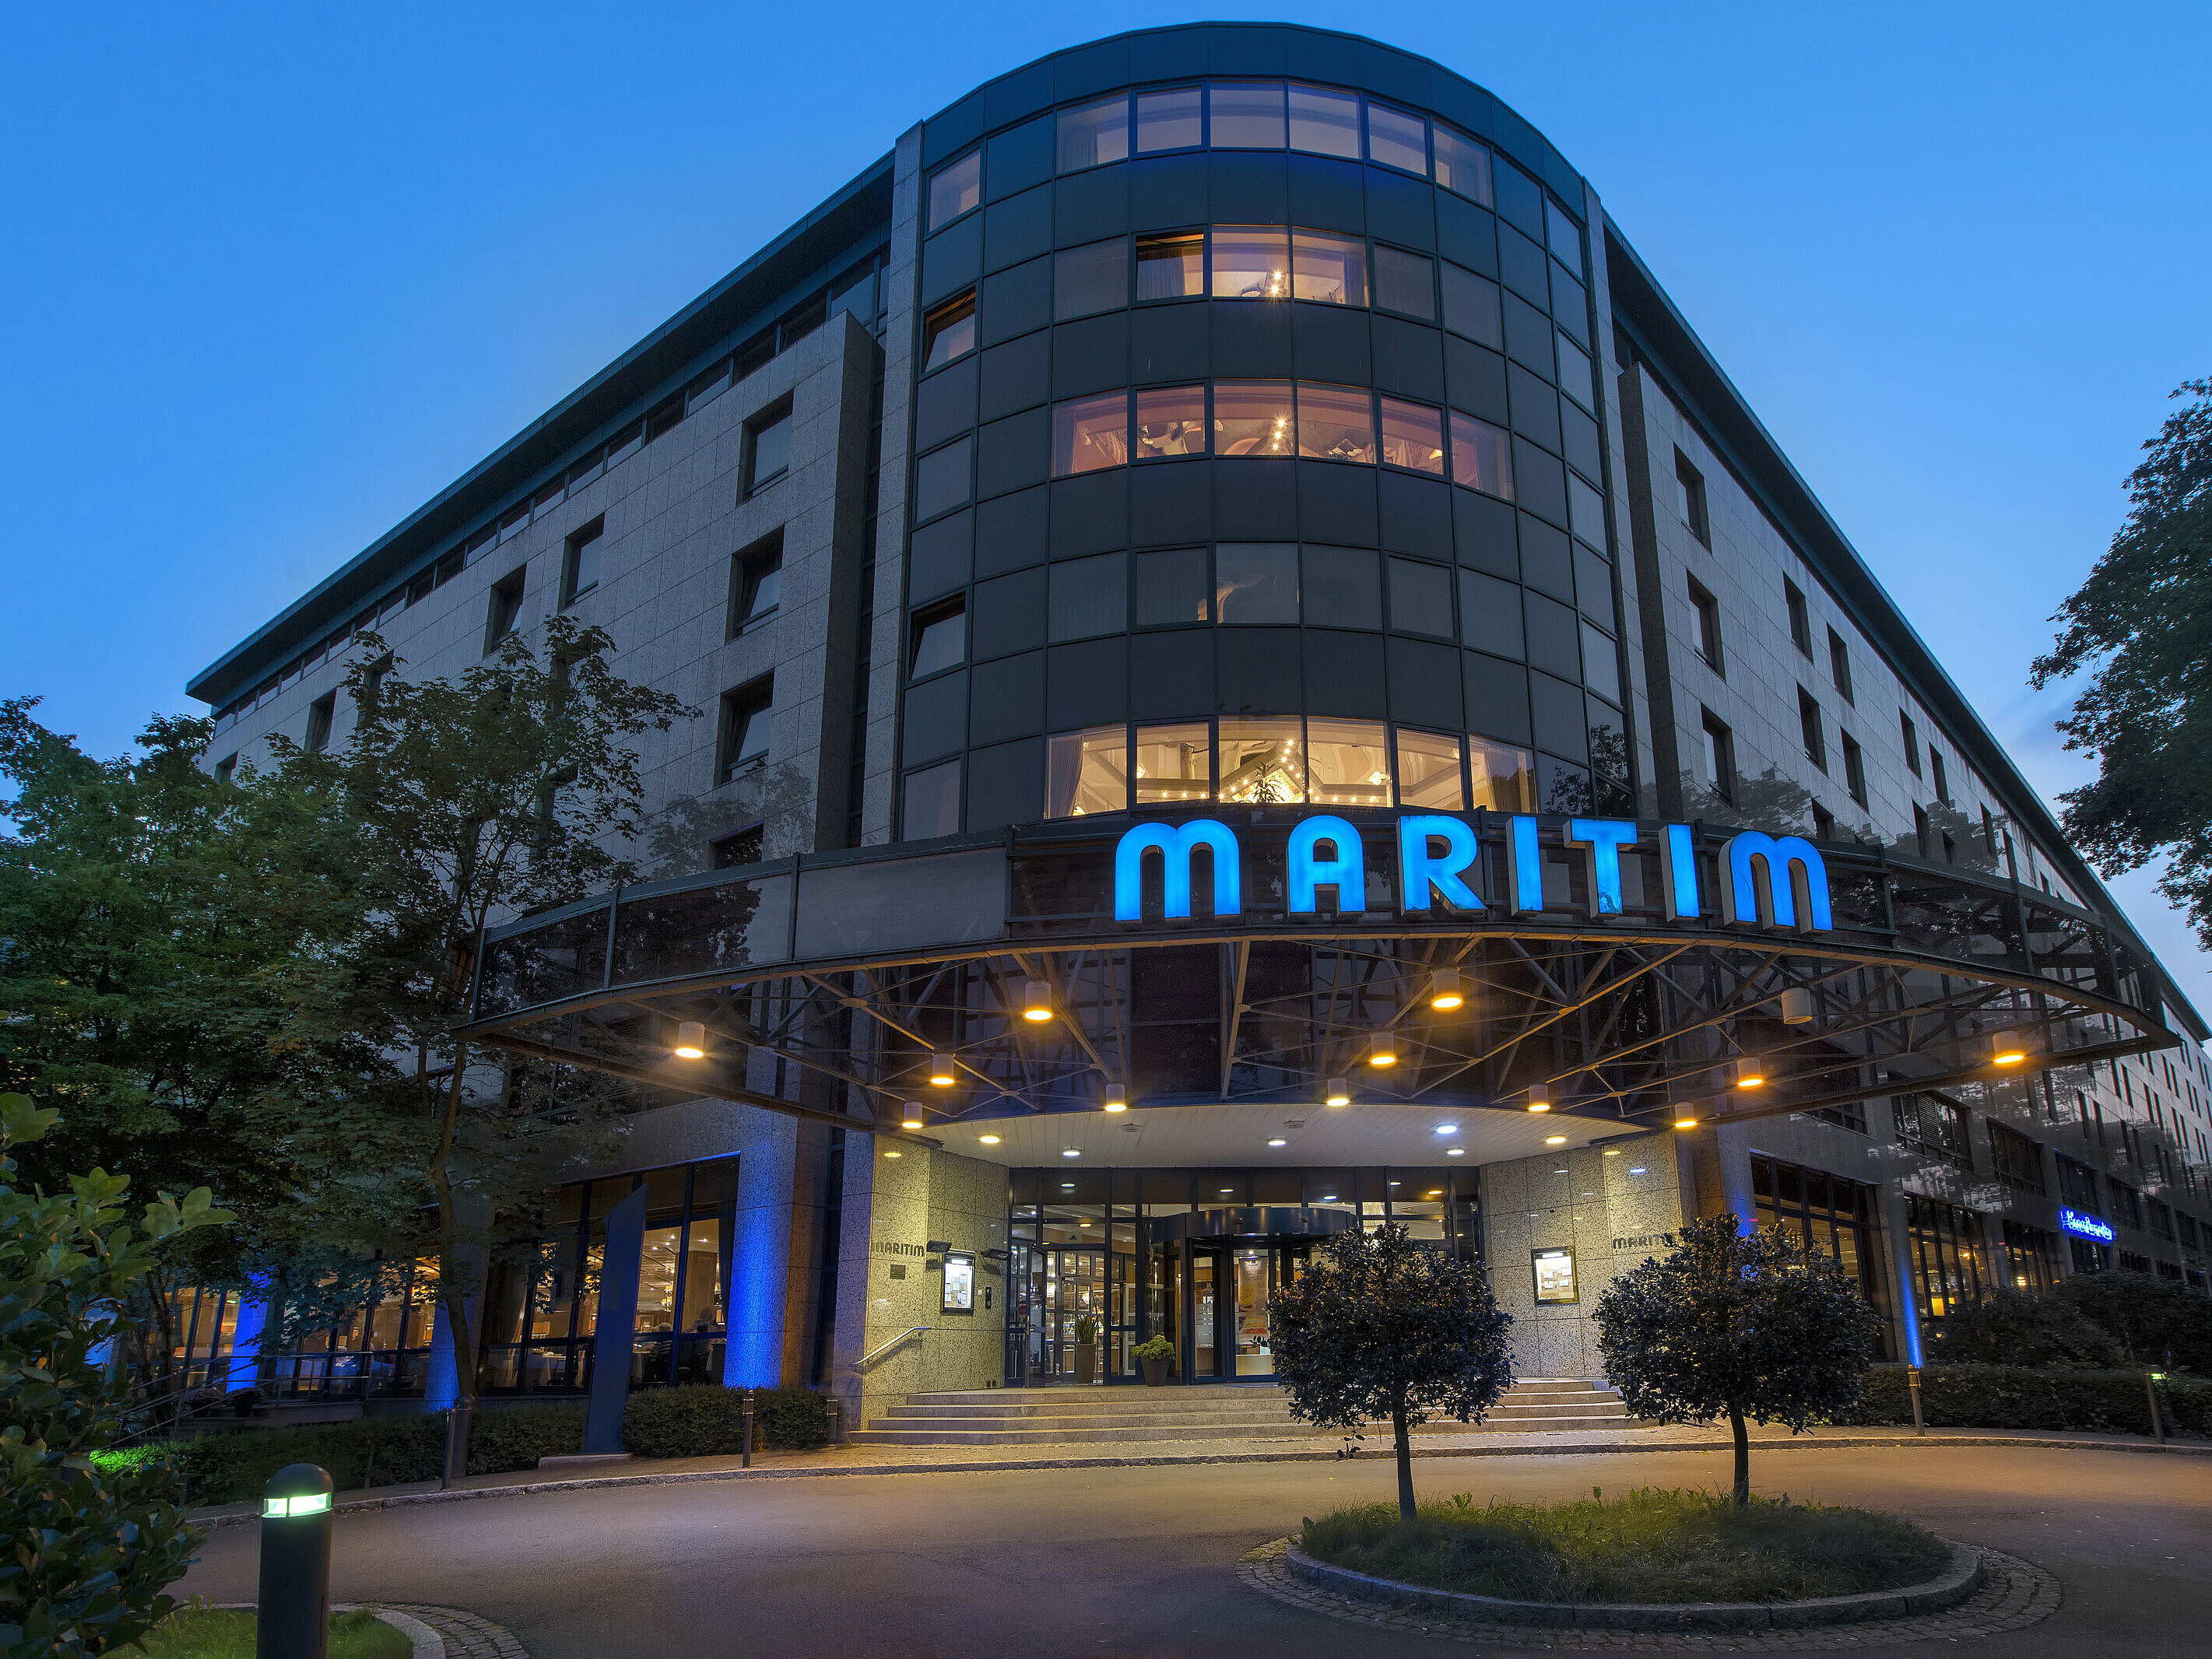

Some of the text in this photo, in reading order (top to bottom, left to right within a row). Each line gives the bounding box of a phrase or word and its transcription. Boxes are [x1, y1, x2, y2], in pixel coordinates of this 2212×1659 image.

[1115, 815, 1833, 931] MARITIM
[872, 1241, 925, 1257] MARITIM
[1613, 1233, 1673, 1249] MARITI
